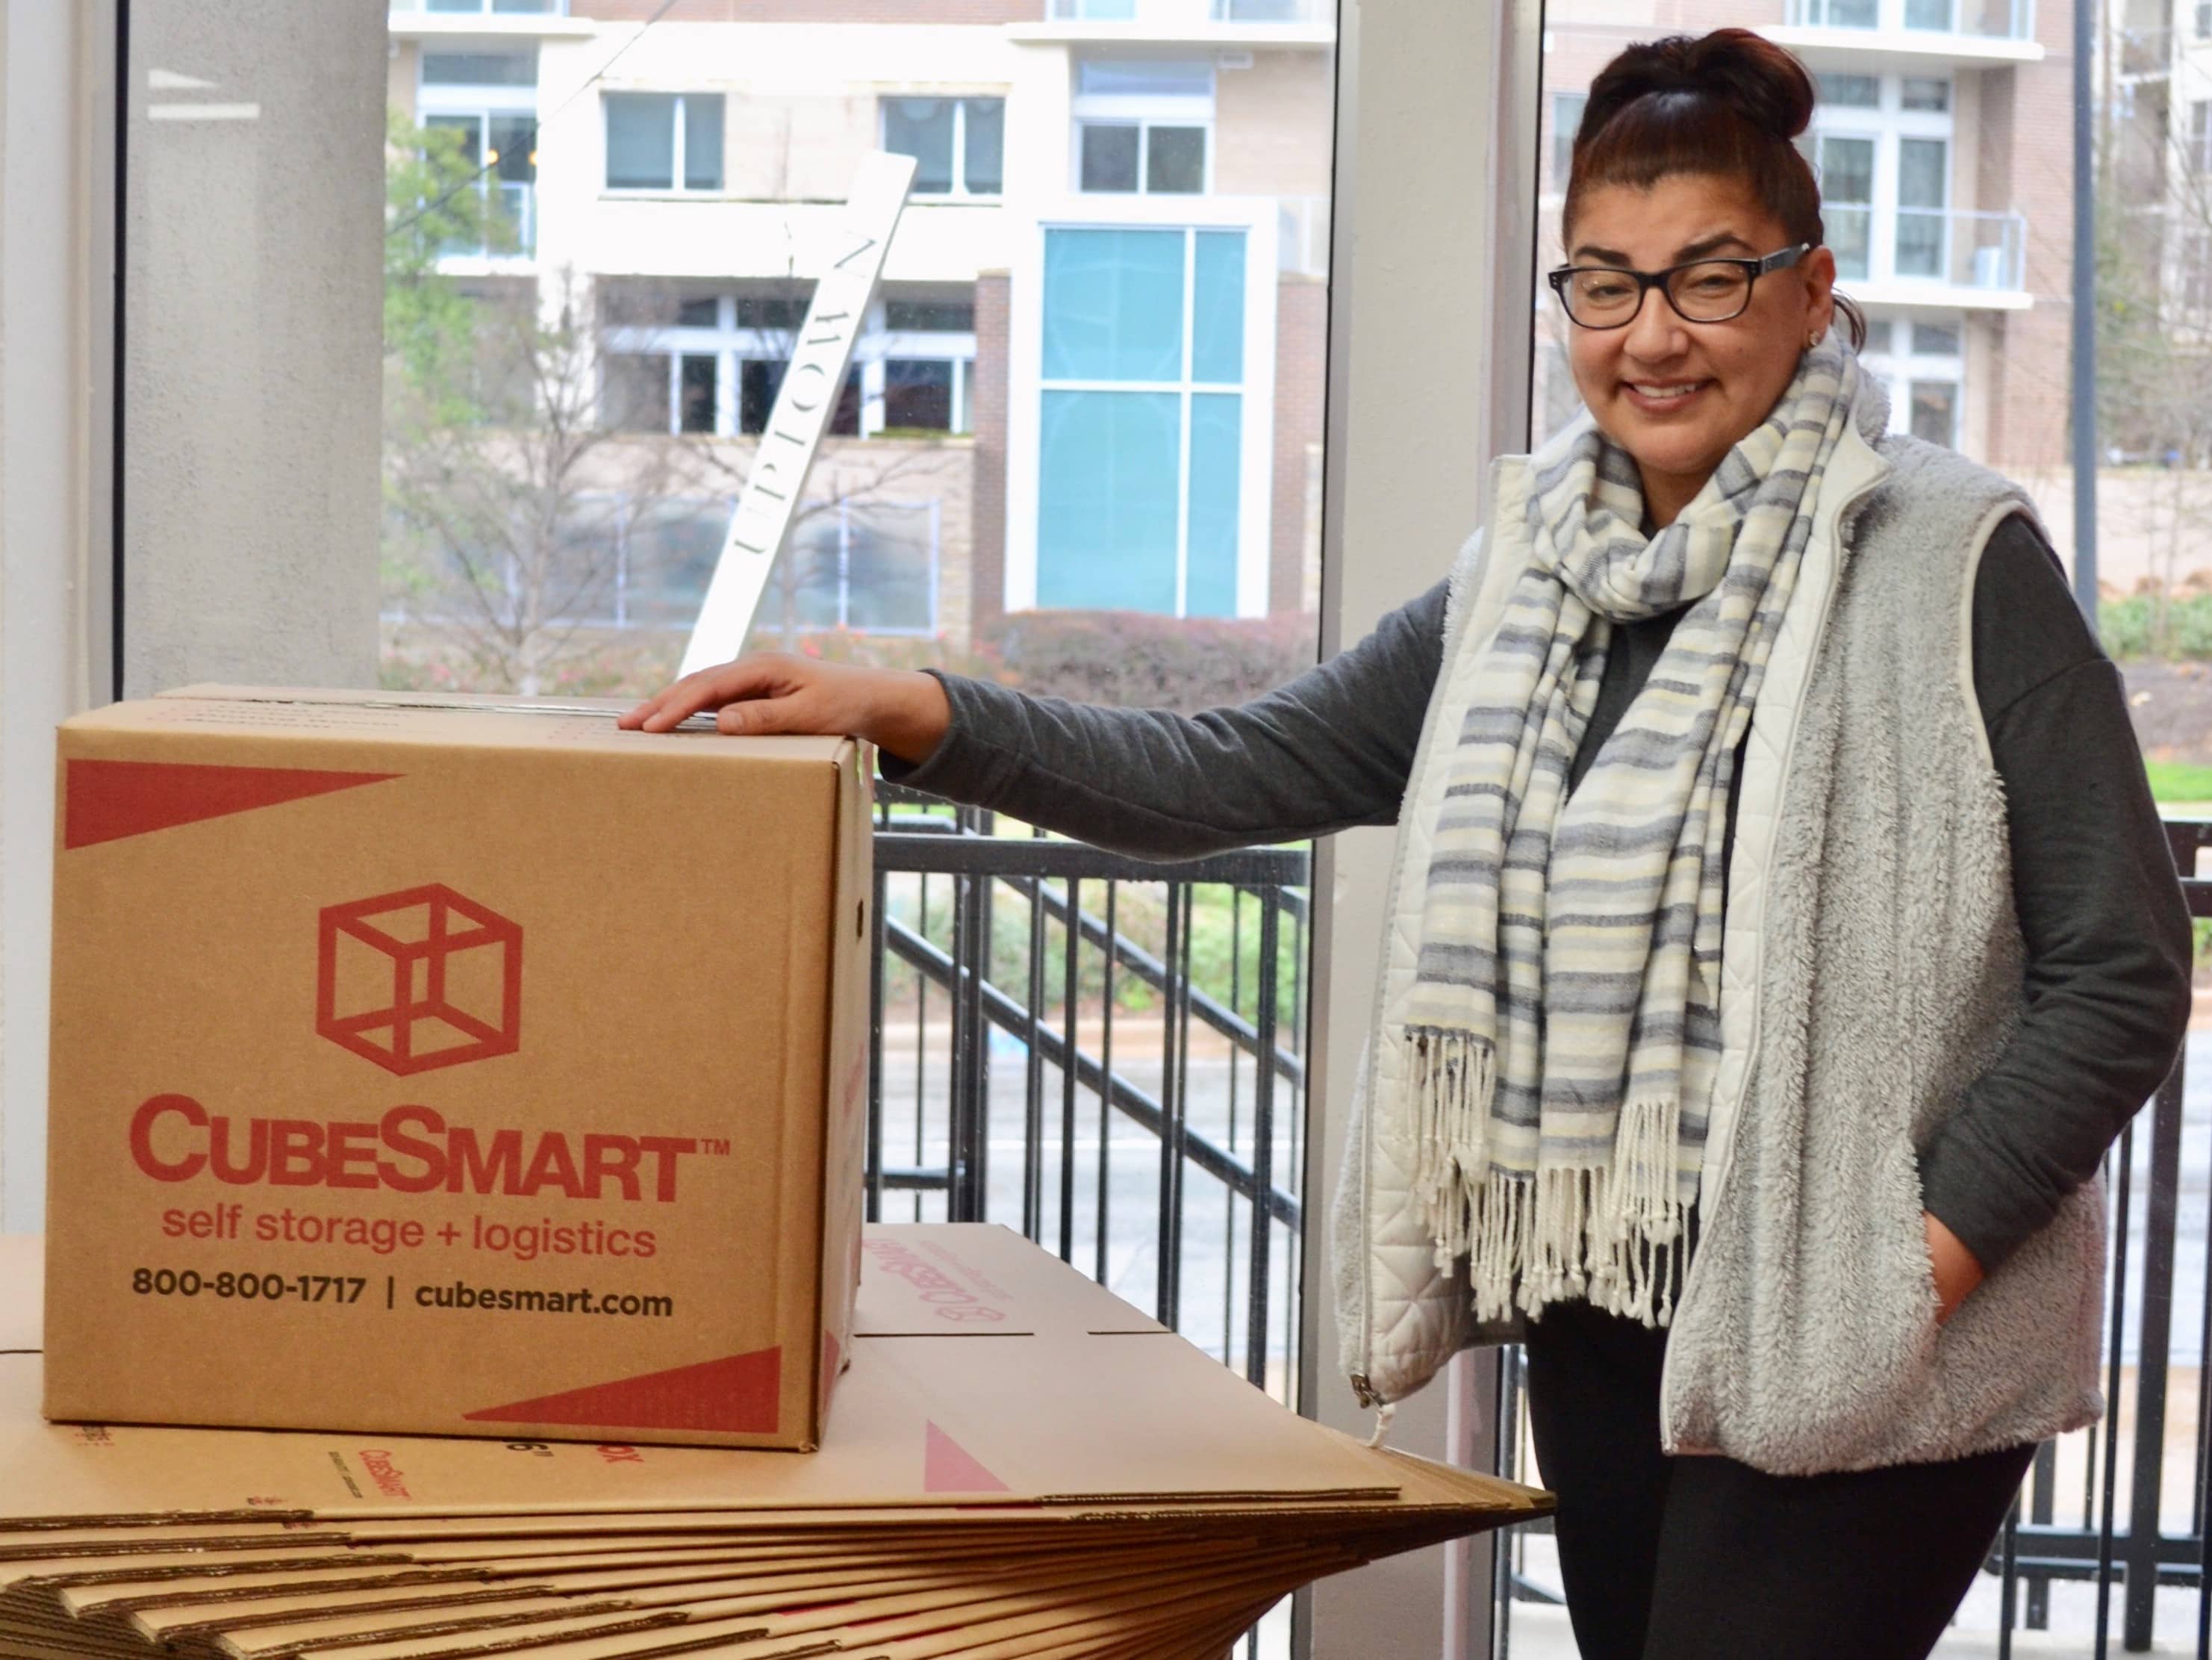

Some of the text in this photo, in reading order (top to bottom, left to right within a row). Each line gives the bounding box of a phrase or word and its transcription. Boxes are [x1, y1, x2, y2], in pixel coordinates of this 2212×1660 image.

[734, 229, 876, 554] UPTOWN
[161, 1202, 243, 1240] self
[255, 1207, 425, 1255] storage
[473, 1214, 657, 1260] logistics
[132, 1266, 673, 1317] 800-800-1717 cubesmart.com
